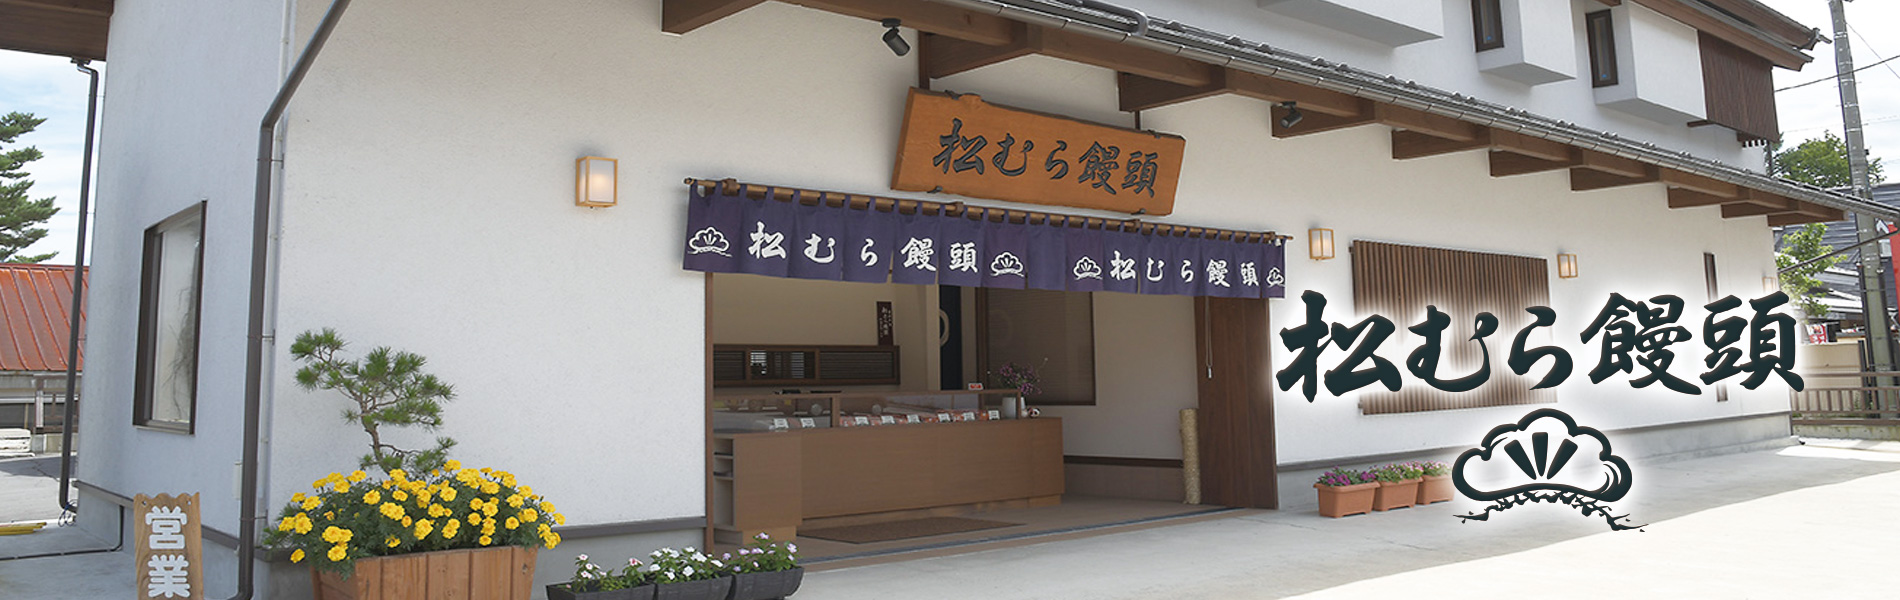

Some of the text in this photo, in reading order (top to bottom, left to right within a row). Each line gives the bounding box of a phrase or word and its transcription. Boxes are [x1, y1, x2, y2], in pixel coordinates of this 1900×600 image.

[933, 117, 1157, 198] 松むら饅頭
[748, 221, 979, 273] 松むら饅頭
[145, 505, 191, 599] 営業
